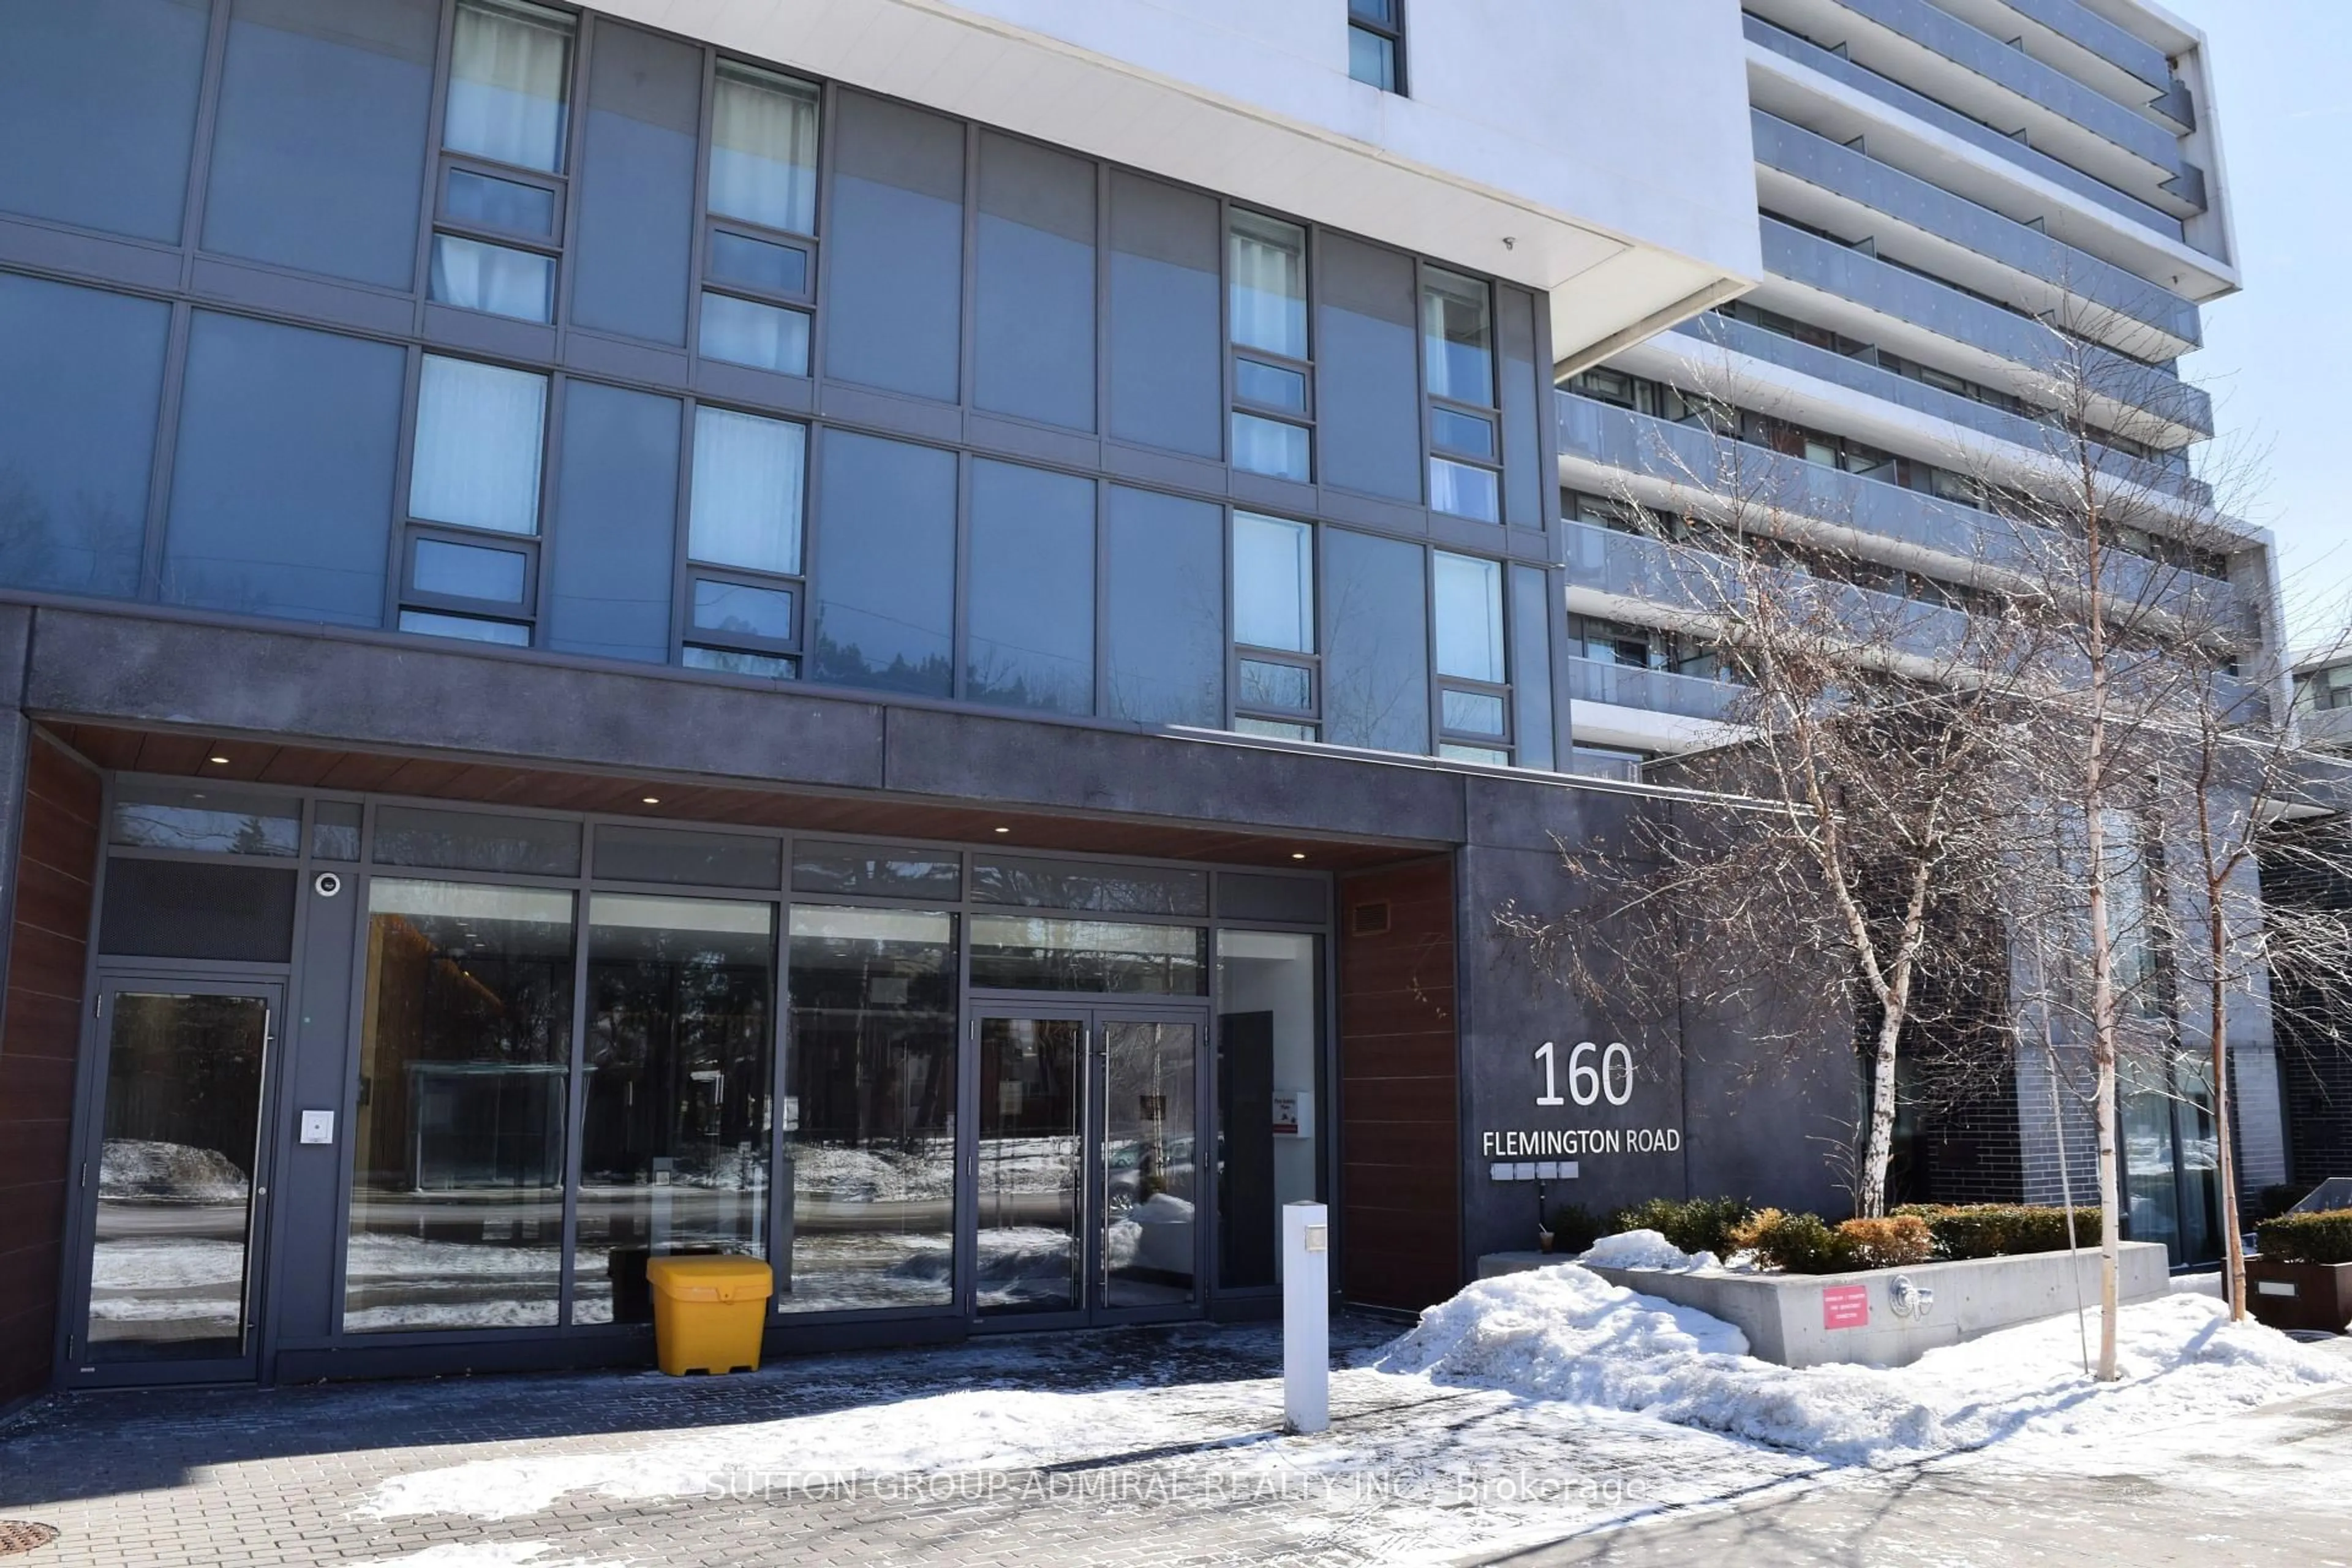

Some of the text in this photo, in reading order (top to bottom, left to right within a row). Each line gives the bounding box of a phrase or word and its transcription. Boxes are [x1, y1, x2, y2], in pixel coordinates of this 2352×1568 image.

[1534, 1042, 1634, 1106] 160
[1483, 1129, 1681, 1156] FLEMINGTON ROAD
